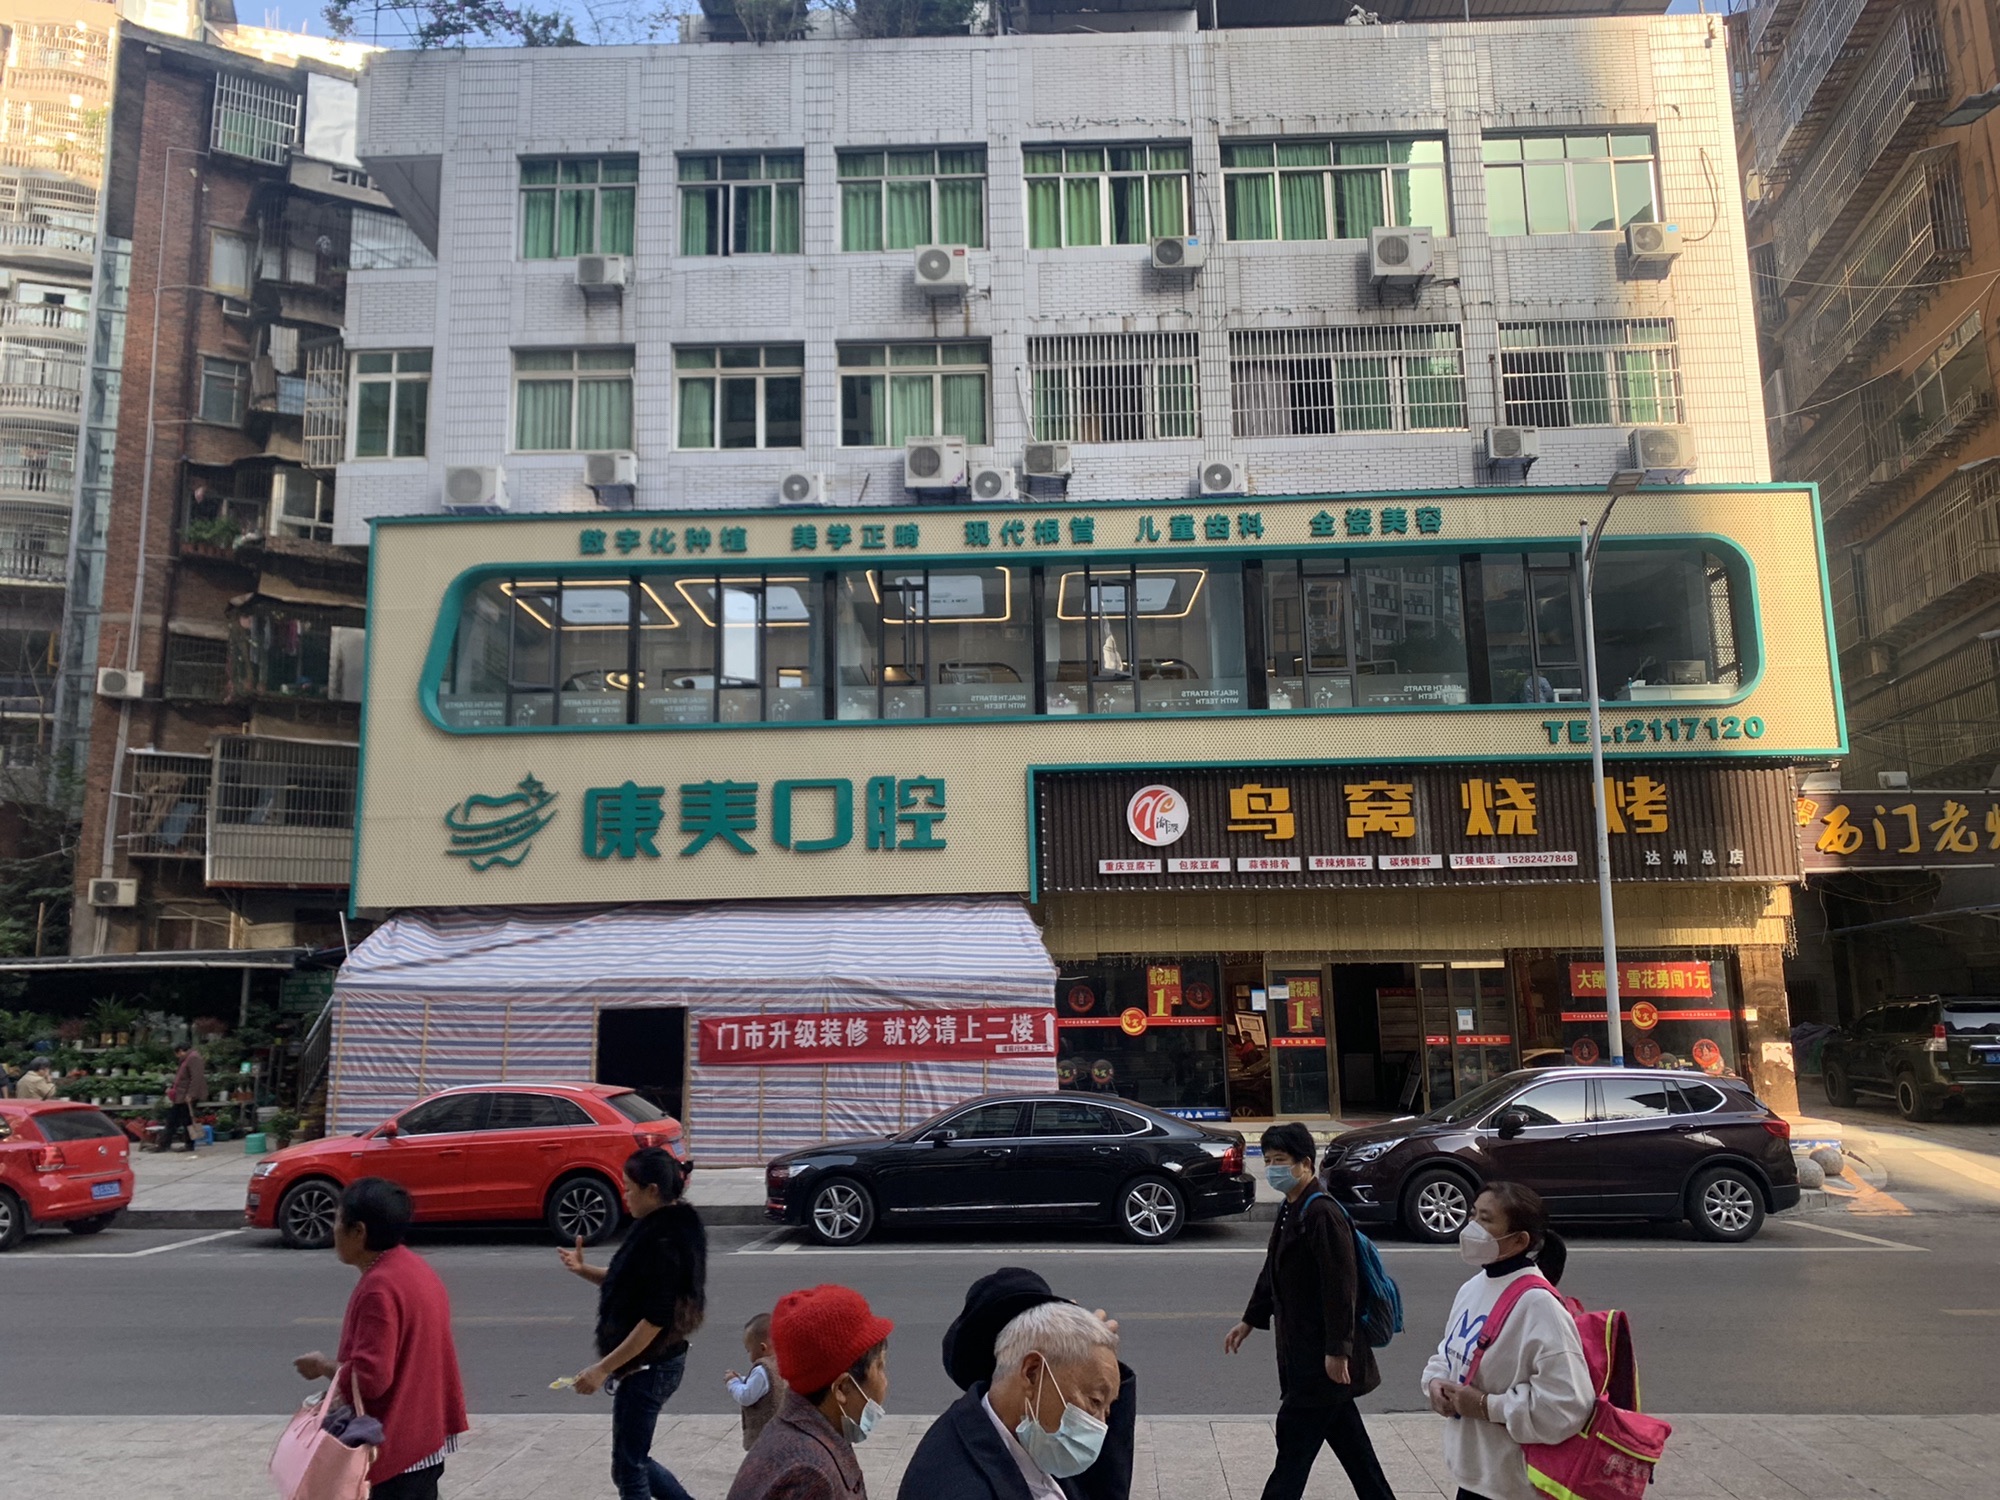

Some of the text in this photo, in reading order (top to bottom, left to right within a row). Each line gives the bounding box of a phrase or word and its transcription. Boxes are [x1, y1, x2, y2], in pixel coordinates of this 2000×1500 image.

[579, 506, 1443, 555] 数字化种植 美学正畸 现代根管 儿童齿科 全瓷美容
[581, 774, 947, 858] 康美口腔
[1227, 776, 1669, 840] 鸟窝烧烤
[1105, 861, 1156, 871] 重庆豆腐干
[1179, 860, 1220, 870] 包浆豆腐
[1248, 859, 1290, 870] 蒜香排骨
[1389, 856, 1431, 867] 碳烤鲜虾
[1507, 853, 1574, 865] 15282427848
[1645, 849, 1745, 867] 达州总店
[1577, 969, 1710, 989] 大酬 雪花勇闯1元
[1151, 988, 1169, 1017] 1
[1291, 1000, 1320, 1029] 1 元
[717, 1013, 1035, 1050] 门市升级装修 就诊请上二楼
